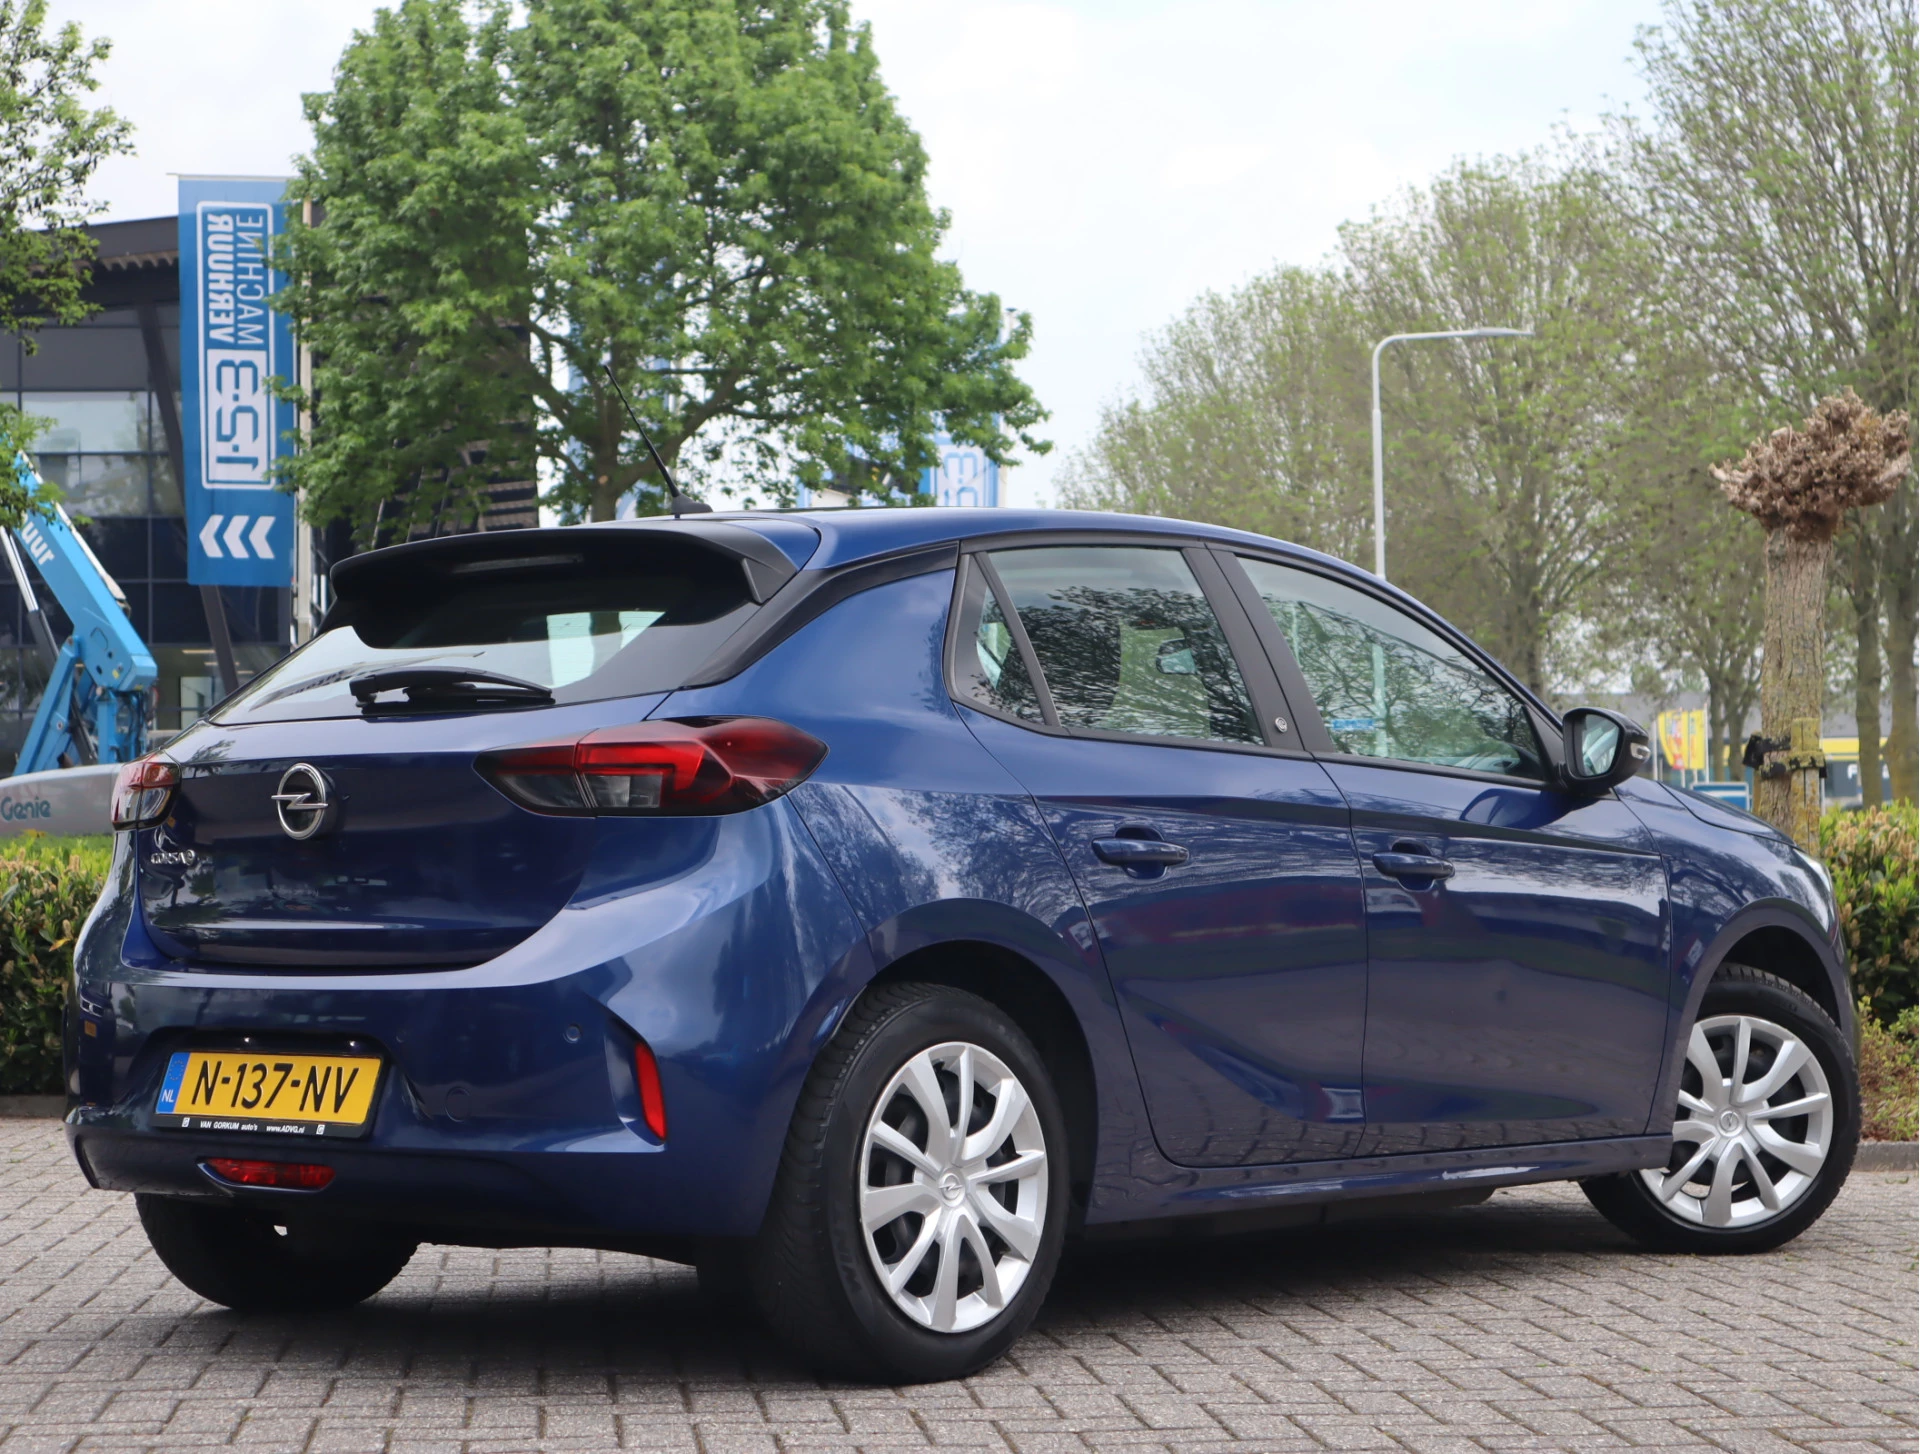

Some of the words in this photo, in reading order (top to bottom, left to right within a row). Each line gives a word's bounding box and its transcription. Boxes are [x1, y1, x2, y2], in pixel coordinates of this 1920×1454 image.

[0, 795, 52, 822] Genie
[161, 1089, 175, 1103] NL
[191, 1060, 360, 1114] N-137-NV
[200, 1120, 211, 1129] VAN
[213, 1121, 240, 1131] GORKUM
[241, 1123, 258, 1132] auto's
